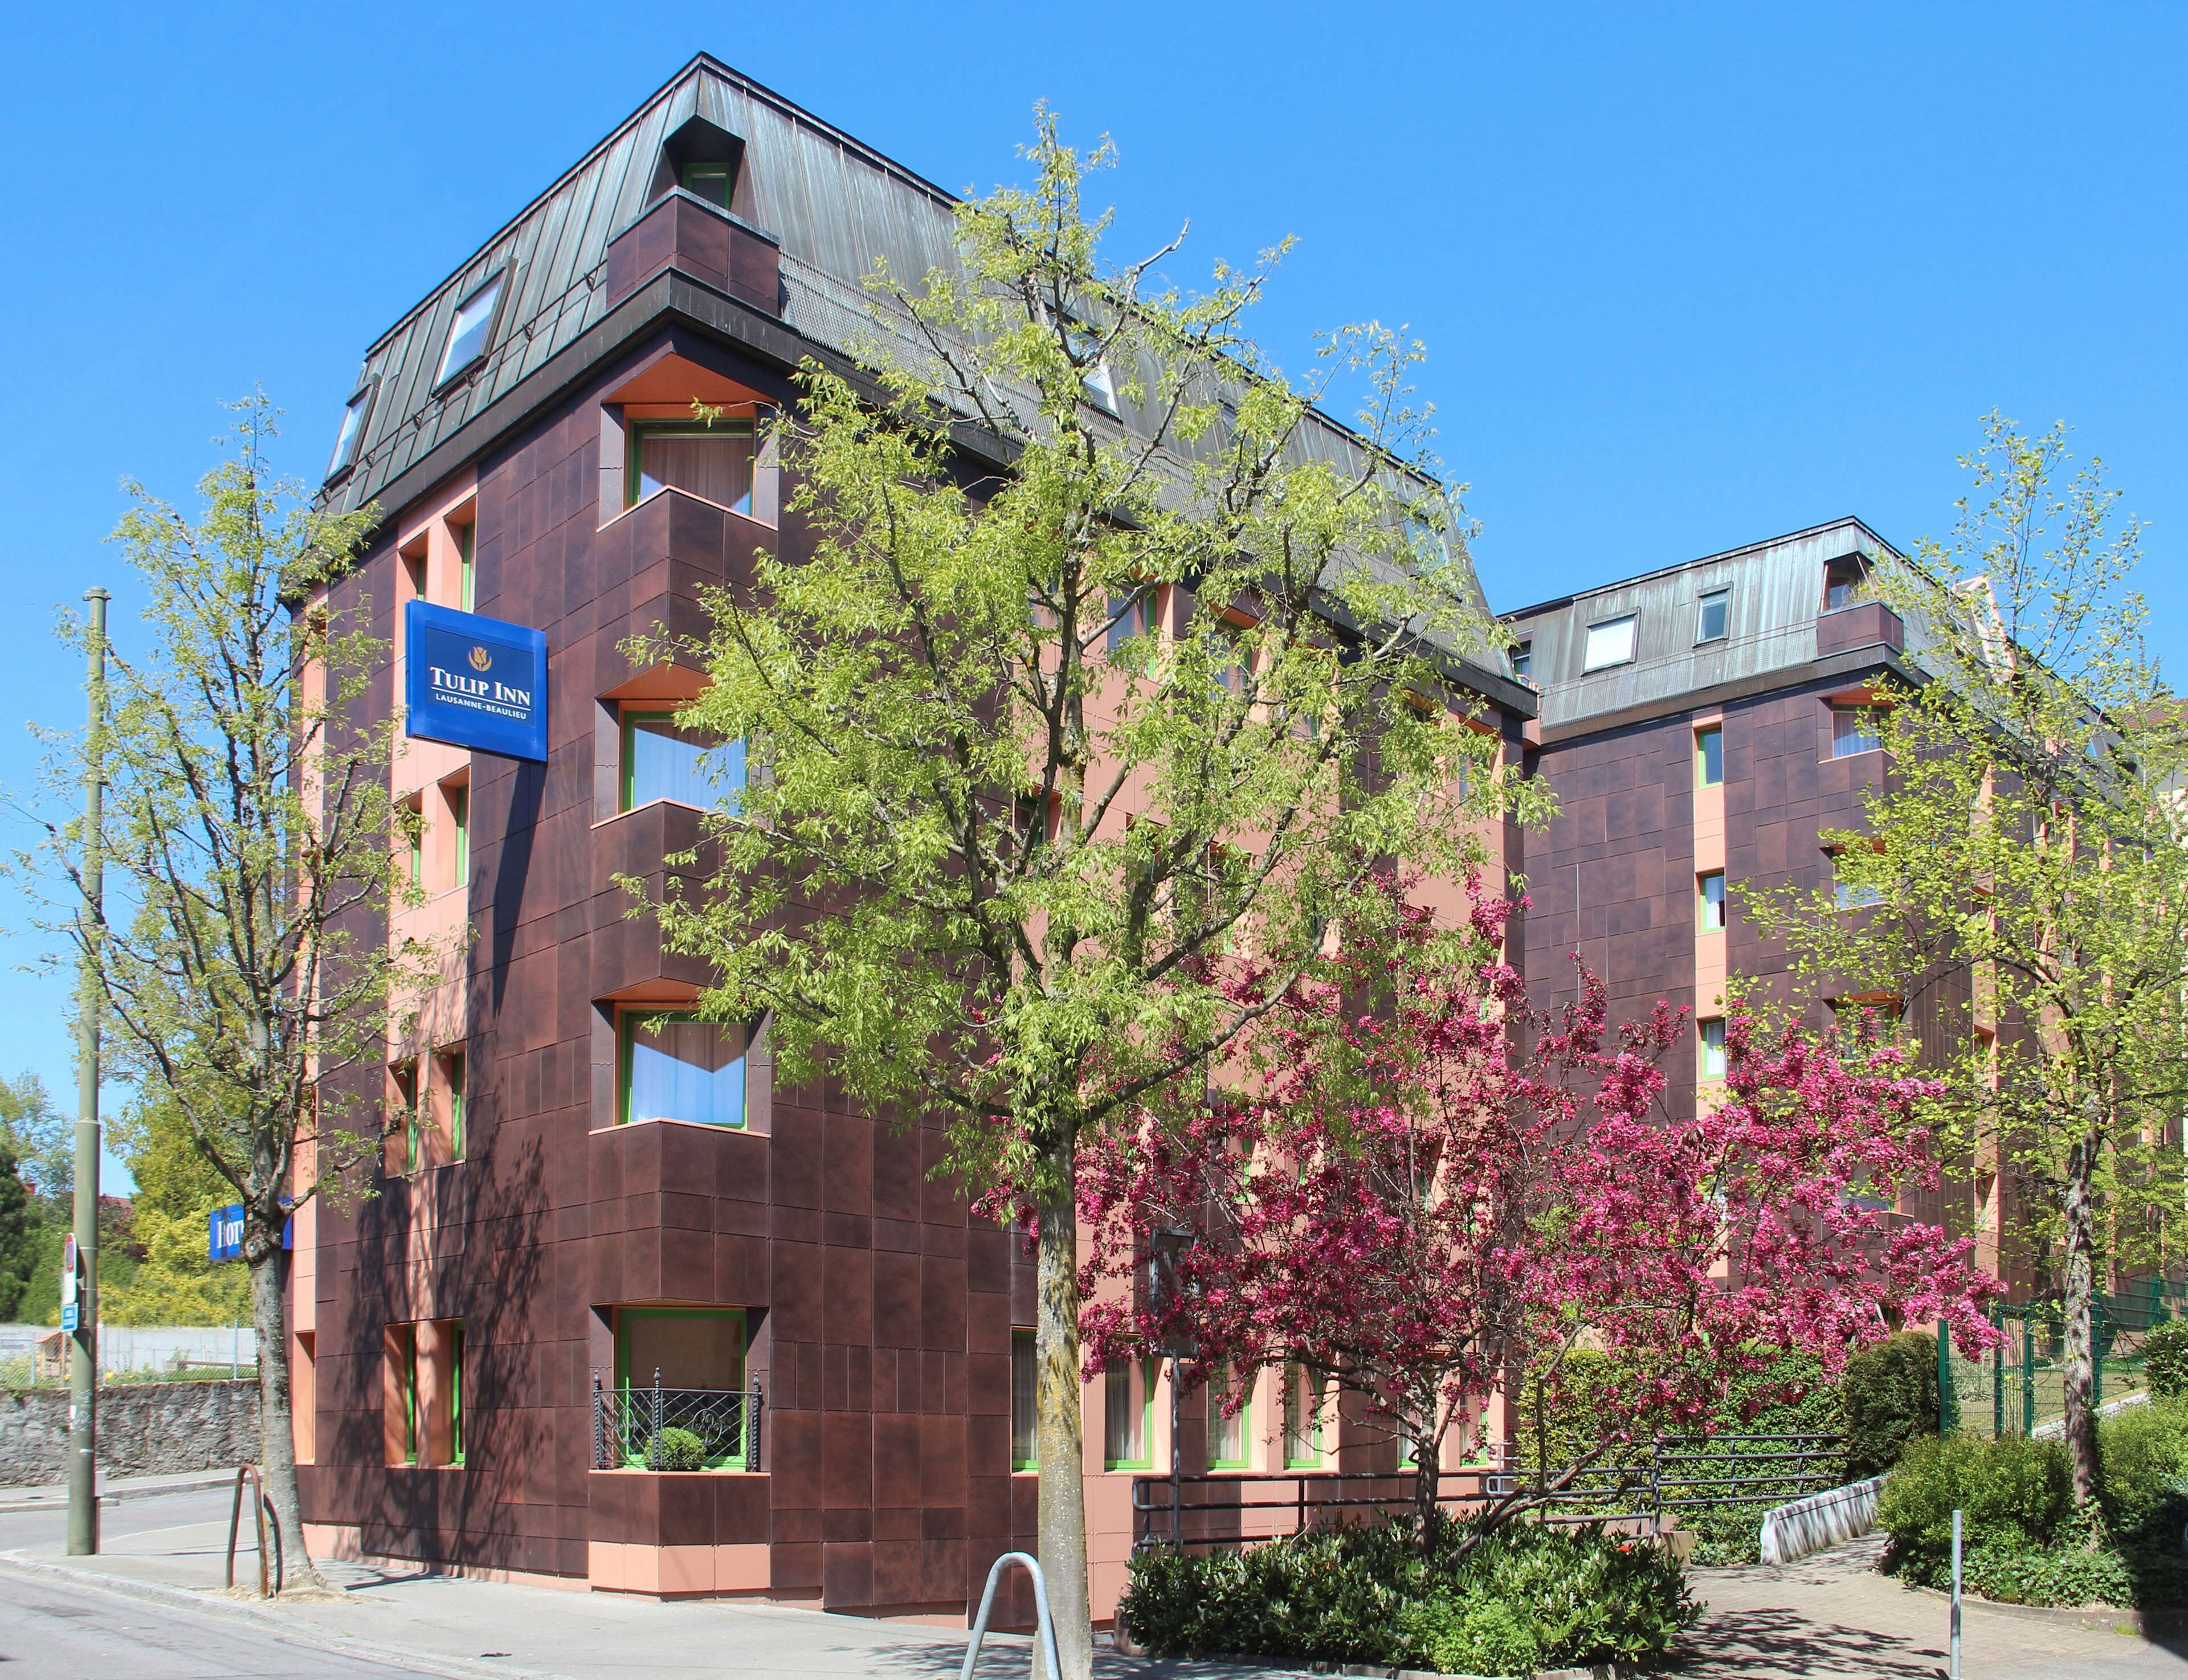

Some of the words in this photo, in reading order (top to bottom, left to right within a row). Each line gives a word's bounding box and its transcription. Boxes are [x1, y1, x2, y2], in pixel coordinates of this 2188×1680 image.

[430, 667, 489, 695] TULIP
[494, 681, 530, 706] INN
[435, 693, 526, 720] LAUSANNE-BEAULIEU
[217, 1220, 244, 1249] HOT
